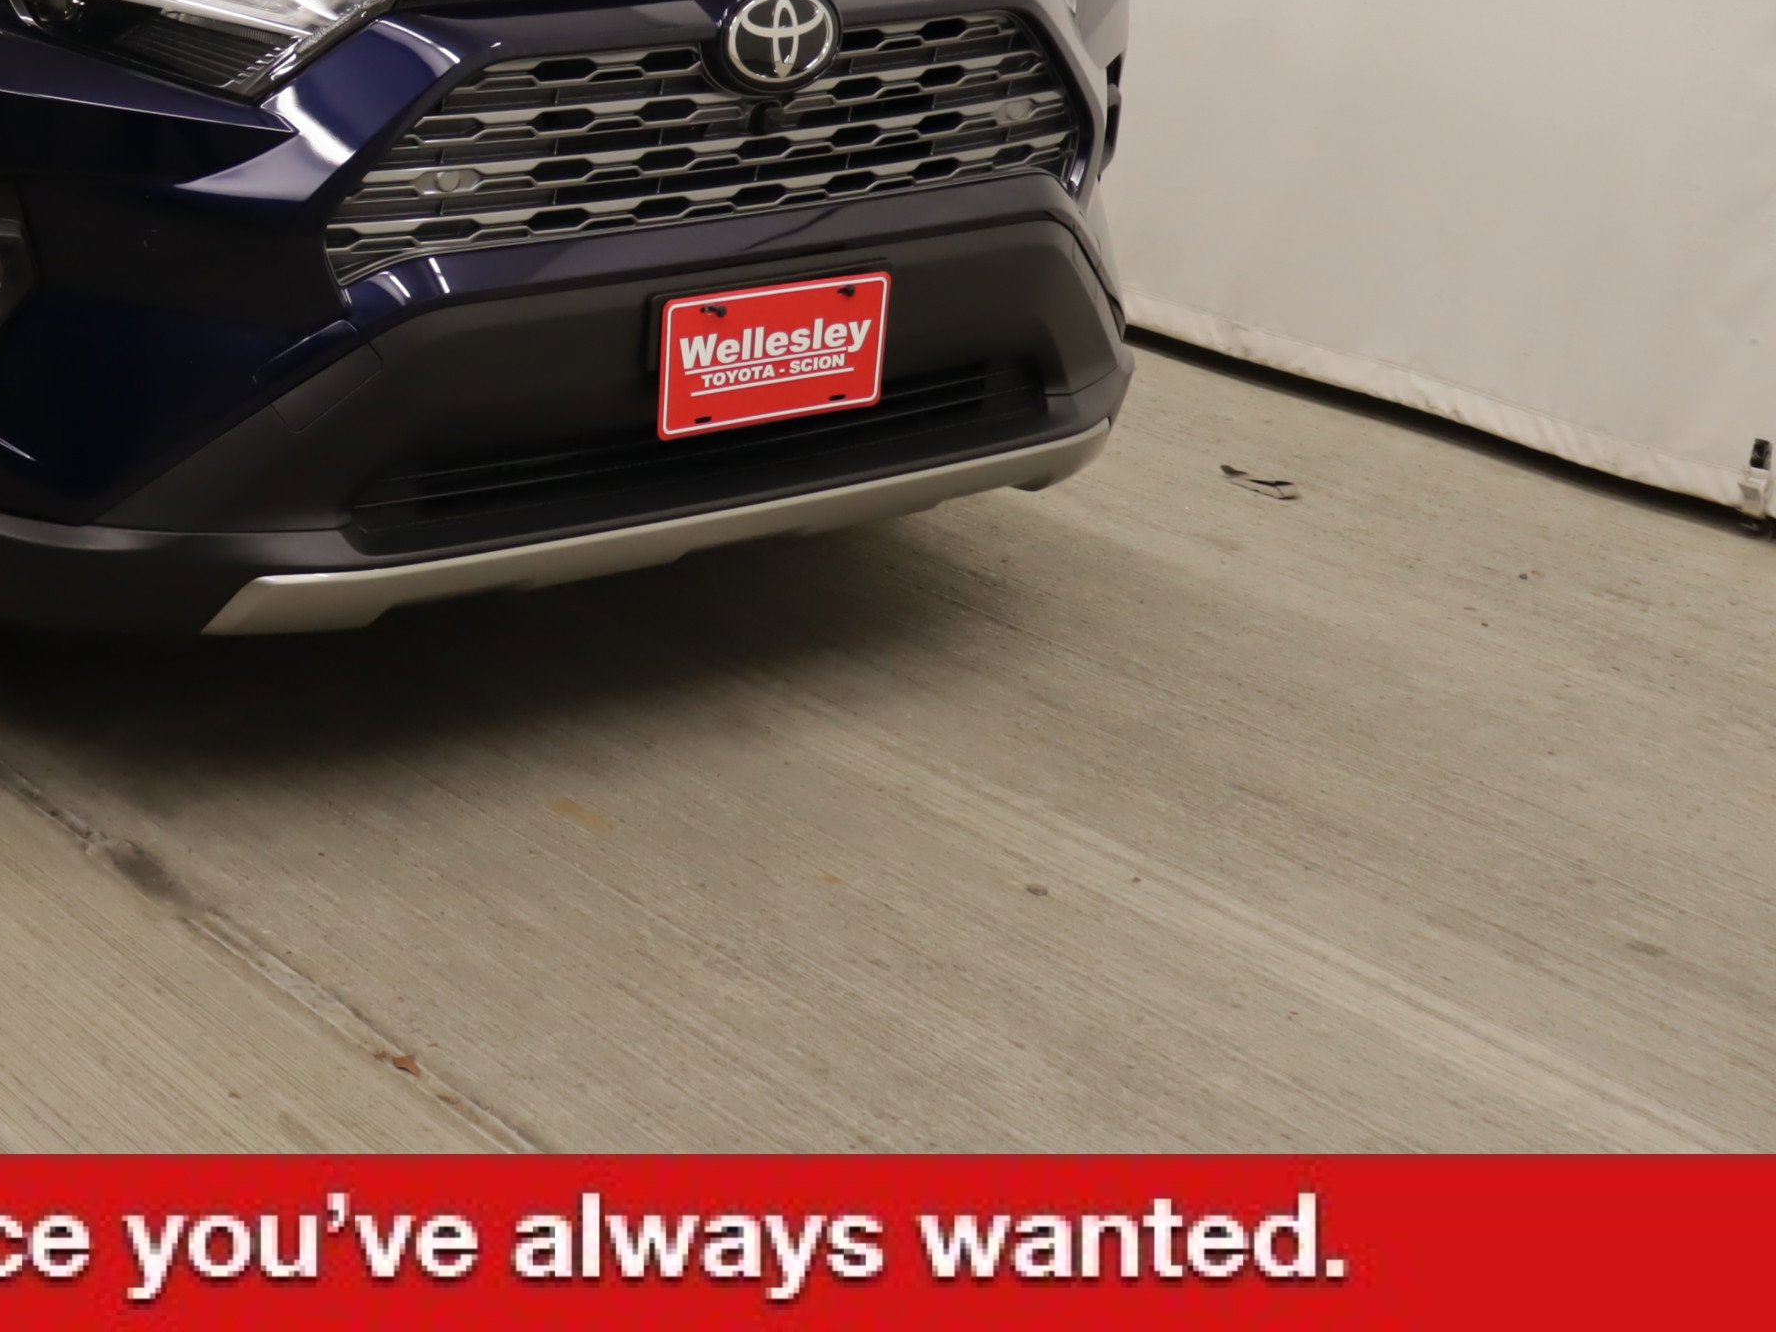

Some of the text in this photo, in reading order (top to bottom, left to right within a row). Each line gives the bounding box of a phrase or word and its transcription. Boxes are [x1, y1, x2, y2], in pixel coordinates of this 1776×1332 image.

[679, 318, 872, 370] Wellesley
[701, 364, 776, 388] TOYOTA
[789, 353, 846, 374] SCION
